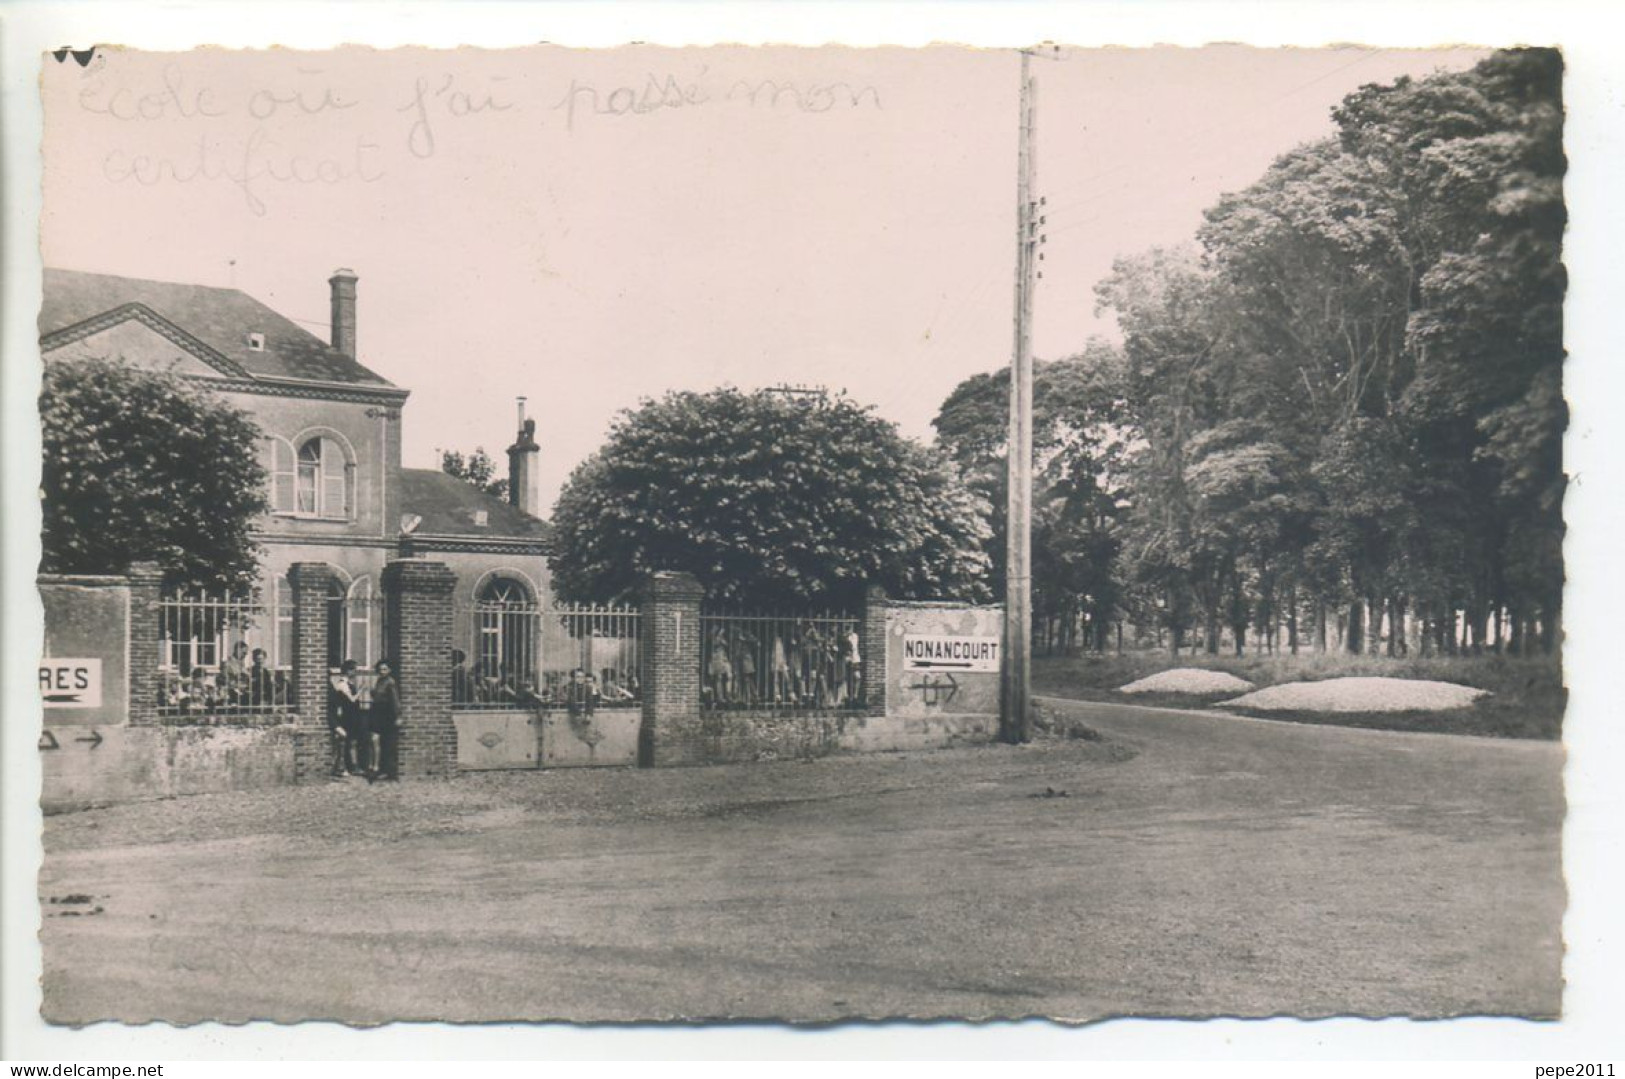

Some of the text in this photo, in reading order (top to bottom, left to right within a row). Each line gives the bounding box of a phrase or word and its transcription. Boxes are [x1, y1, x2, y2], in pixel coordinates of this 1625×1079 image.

[396, 73, 514, 160] j'ai
[553, 63, 712, 138] passé
[725, 79, 884, 114] mon
[103, 126, 387, 217] certificat
[39, 667, 88, 690] RES
[905, 640, 998, 660] NONANCOURT
